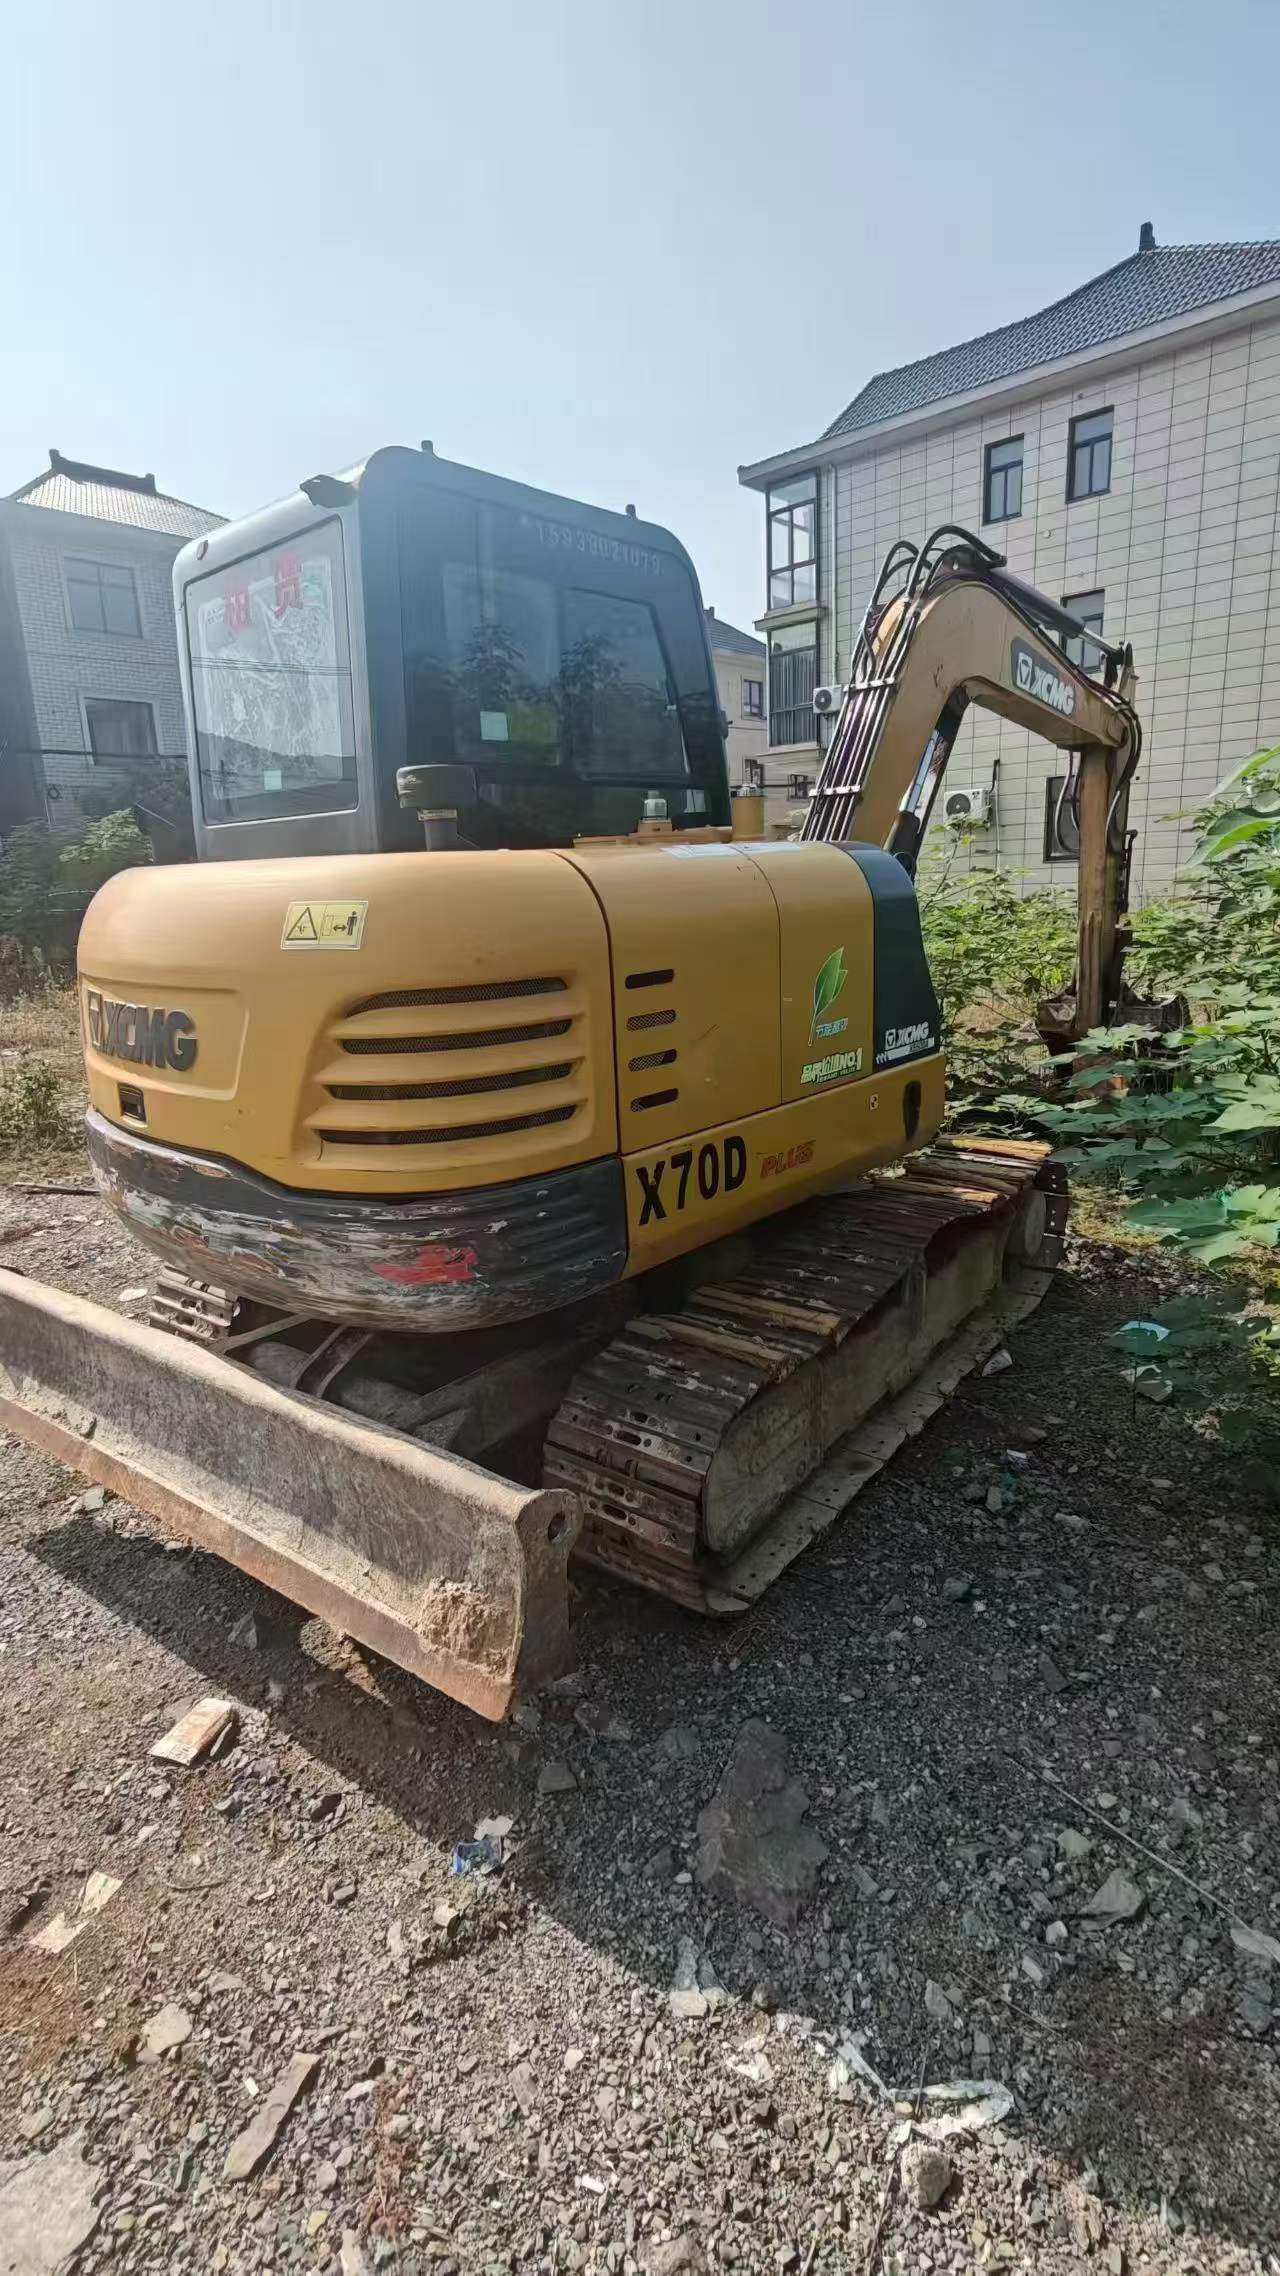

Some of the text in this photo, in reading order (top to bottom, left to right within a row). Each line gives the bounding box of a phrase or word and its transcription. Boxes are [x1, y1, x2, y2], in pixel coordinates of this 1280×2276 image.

[1031, 666, 1075, 715] XCMG
[102, 999, 198, 1072] XCMG
[895, 1021, 929, 1047] XCMG
[636, 1135, 747, 1225] X70D
